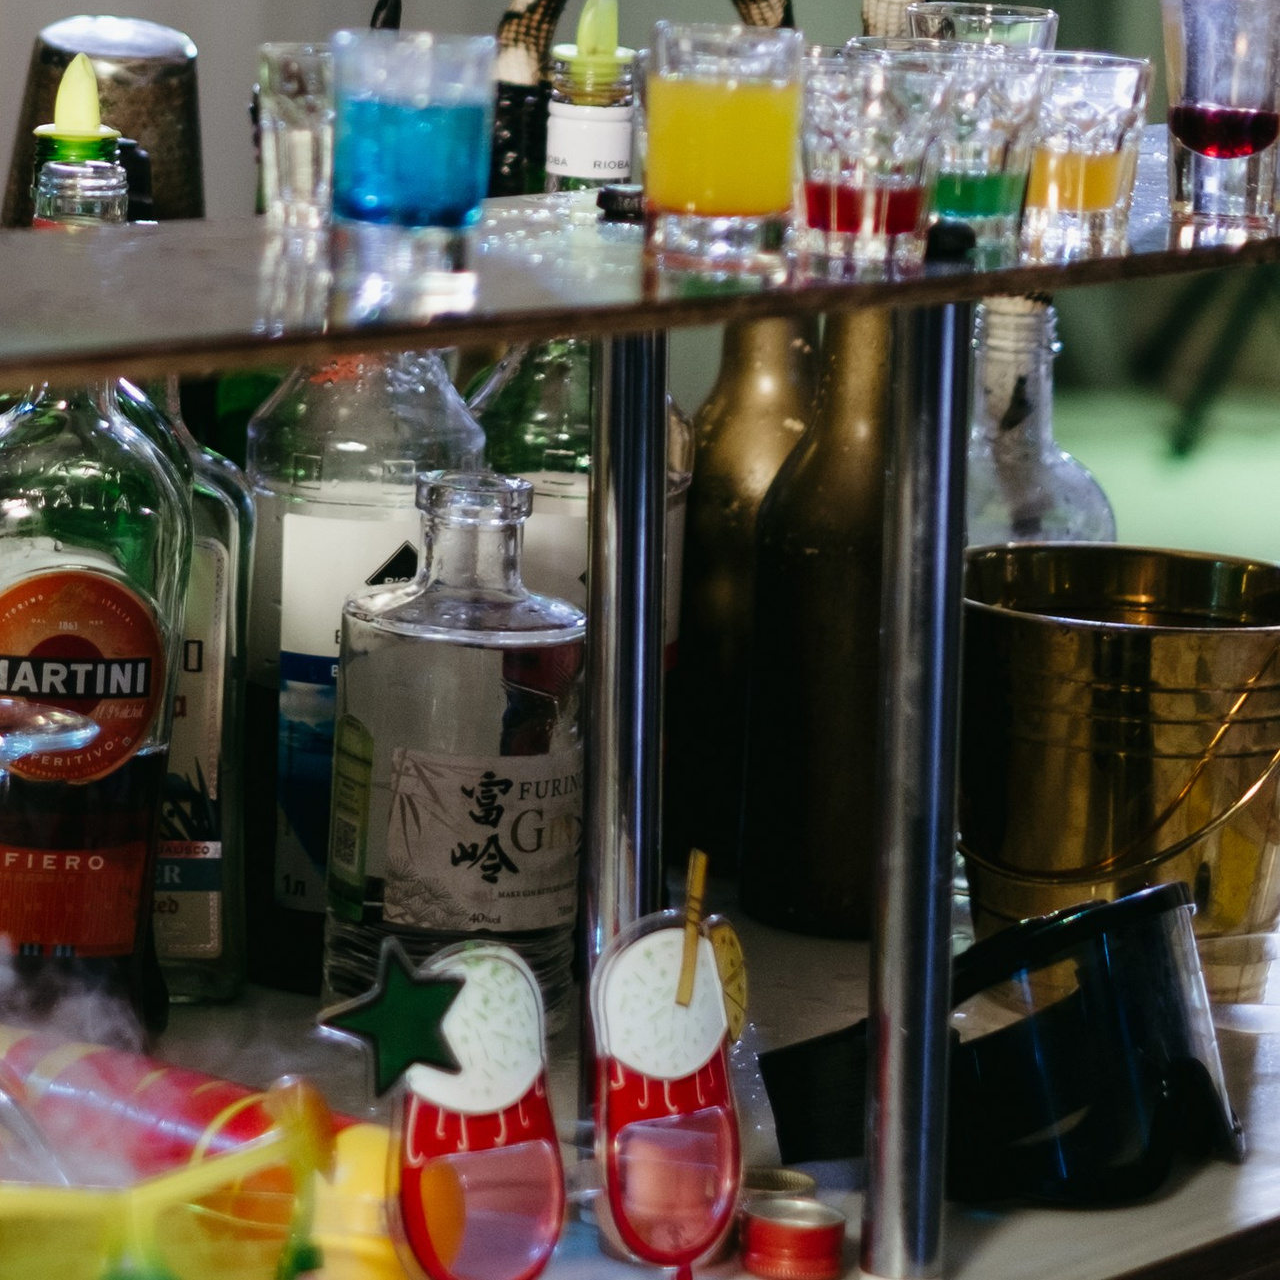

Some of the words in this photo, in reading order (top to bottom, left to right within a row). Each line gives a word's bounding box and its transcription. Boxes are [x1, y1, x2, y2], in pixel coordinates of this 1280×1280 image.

[593, 160, 630, 170] RIOBA
[5, 594, 44, 619] TORINO
[101, 598, 131, 622] ITALIA
[30, 741, 114, 767] PERITIVO
[4, 852, 105, 870] FIERO
